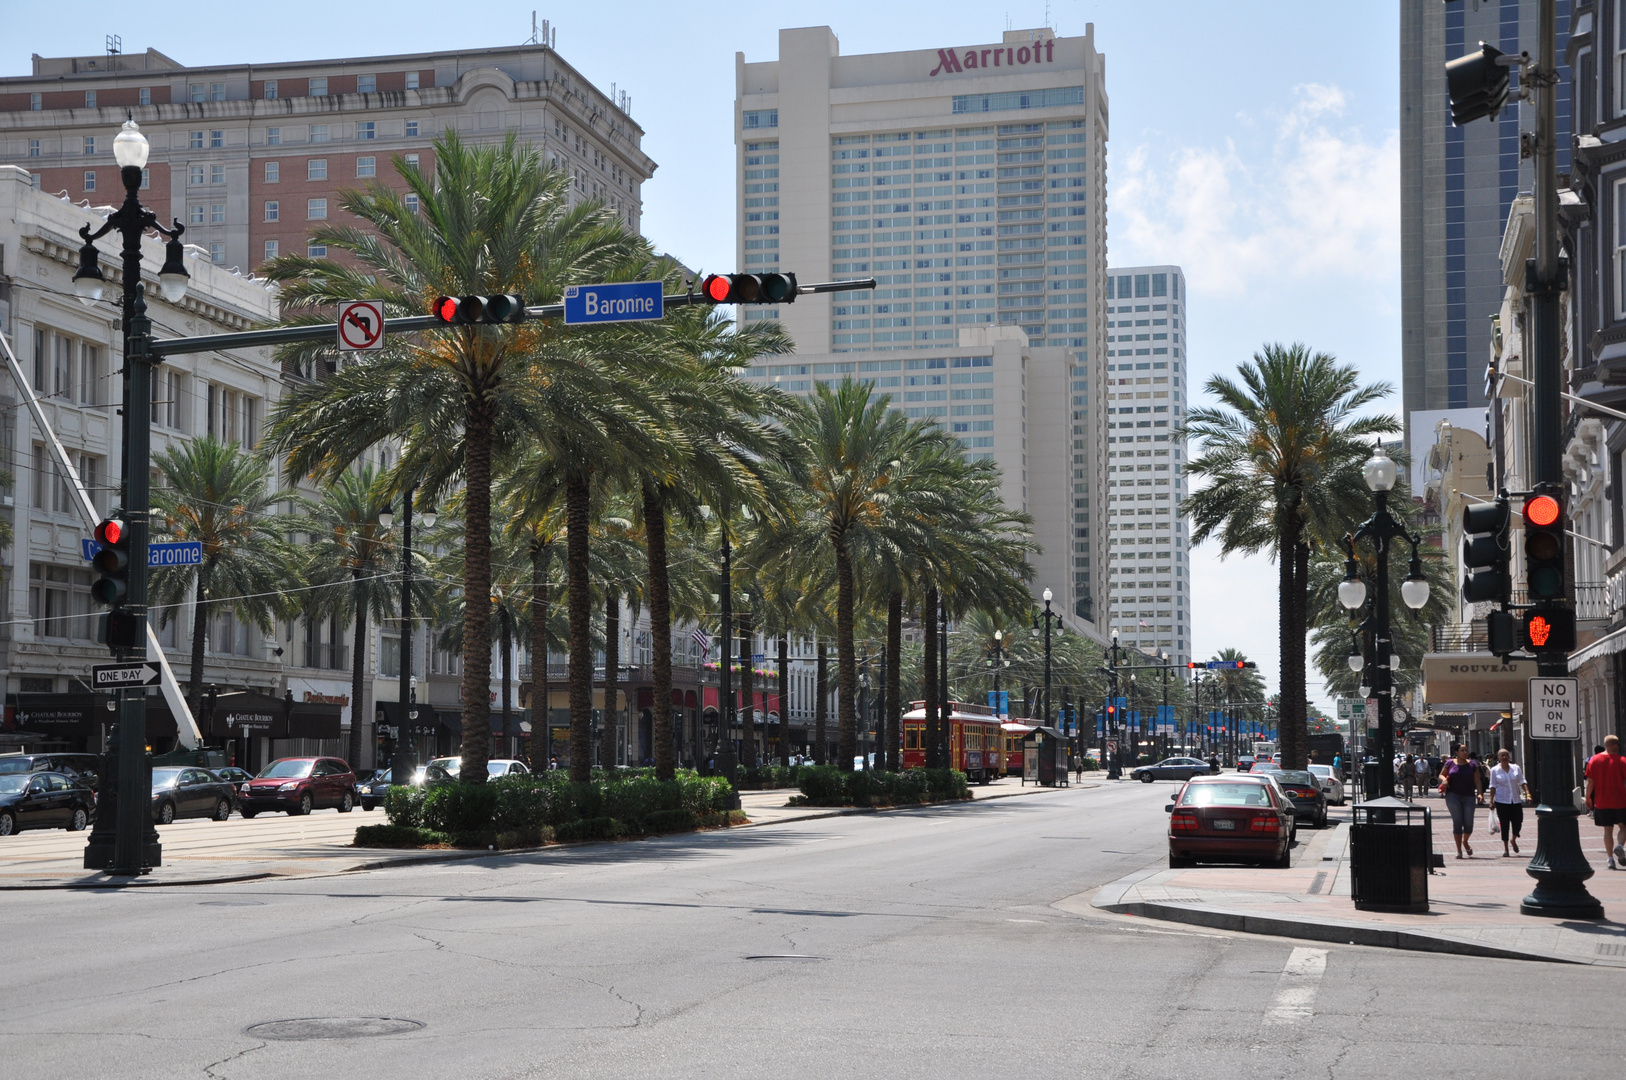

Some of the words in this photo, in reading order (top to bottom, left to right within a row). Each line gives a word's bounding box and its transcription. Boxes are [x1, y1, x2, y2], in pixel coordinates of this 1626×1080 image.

[929, 39, 1055, 77] Marriott
[585, 292, 654, 316] Baronne
[1450, 664, 1518, 673] NOUVEAU
[100, 671, 119, 682] ONE
[1543, 684, 1566, 696] NO
[1540, 699, 1570, 708] TURN
[1547, 711, 1563, 721] ON
[1544, 724, 1567, 733] RED
